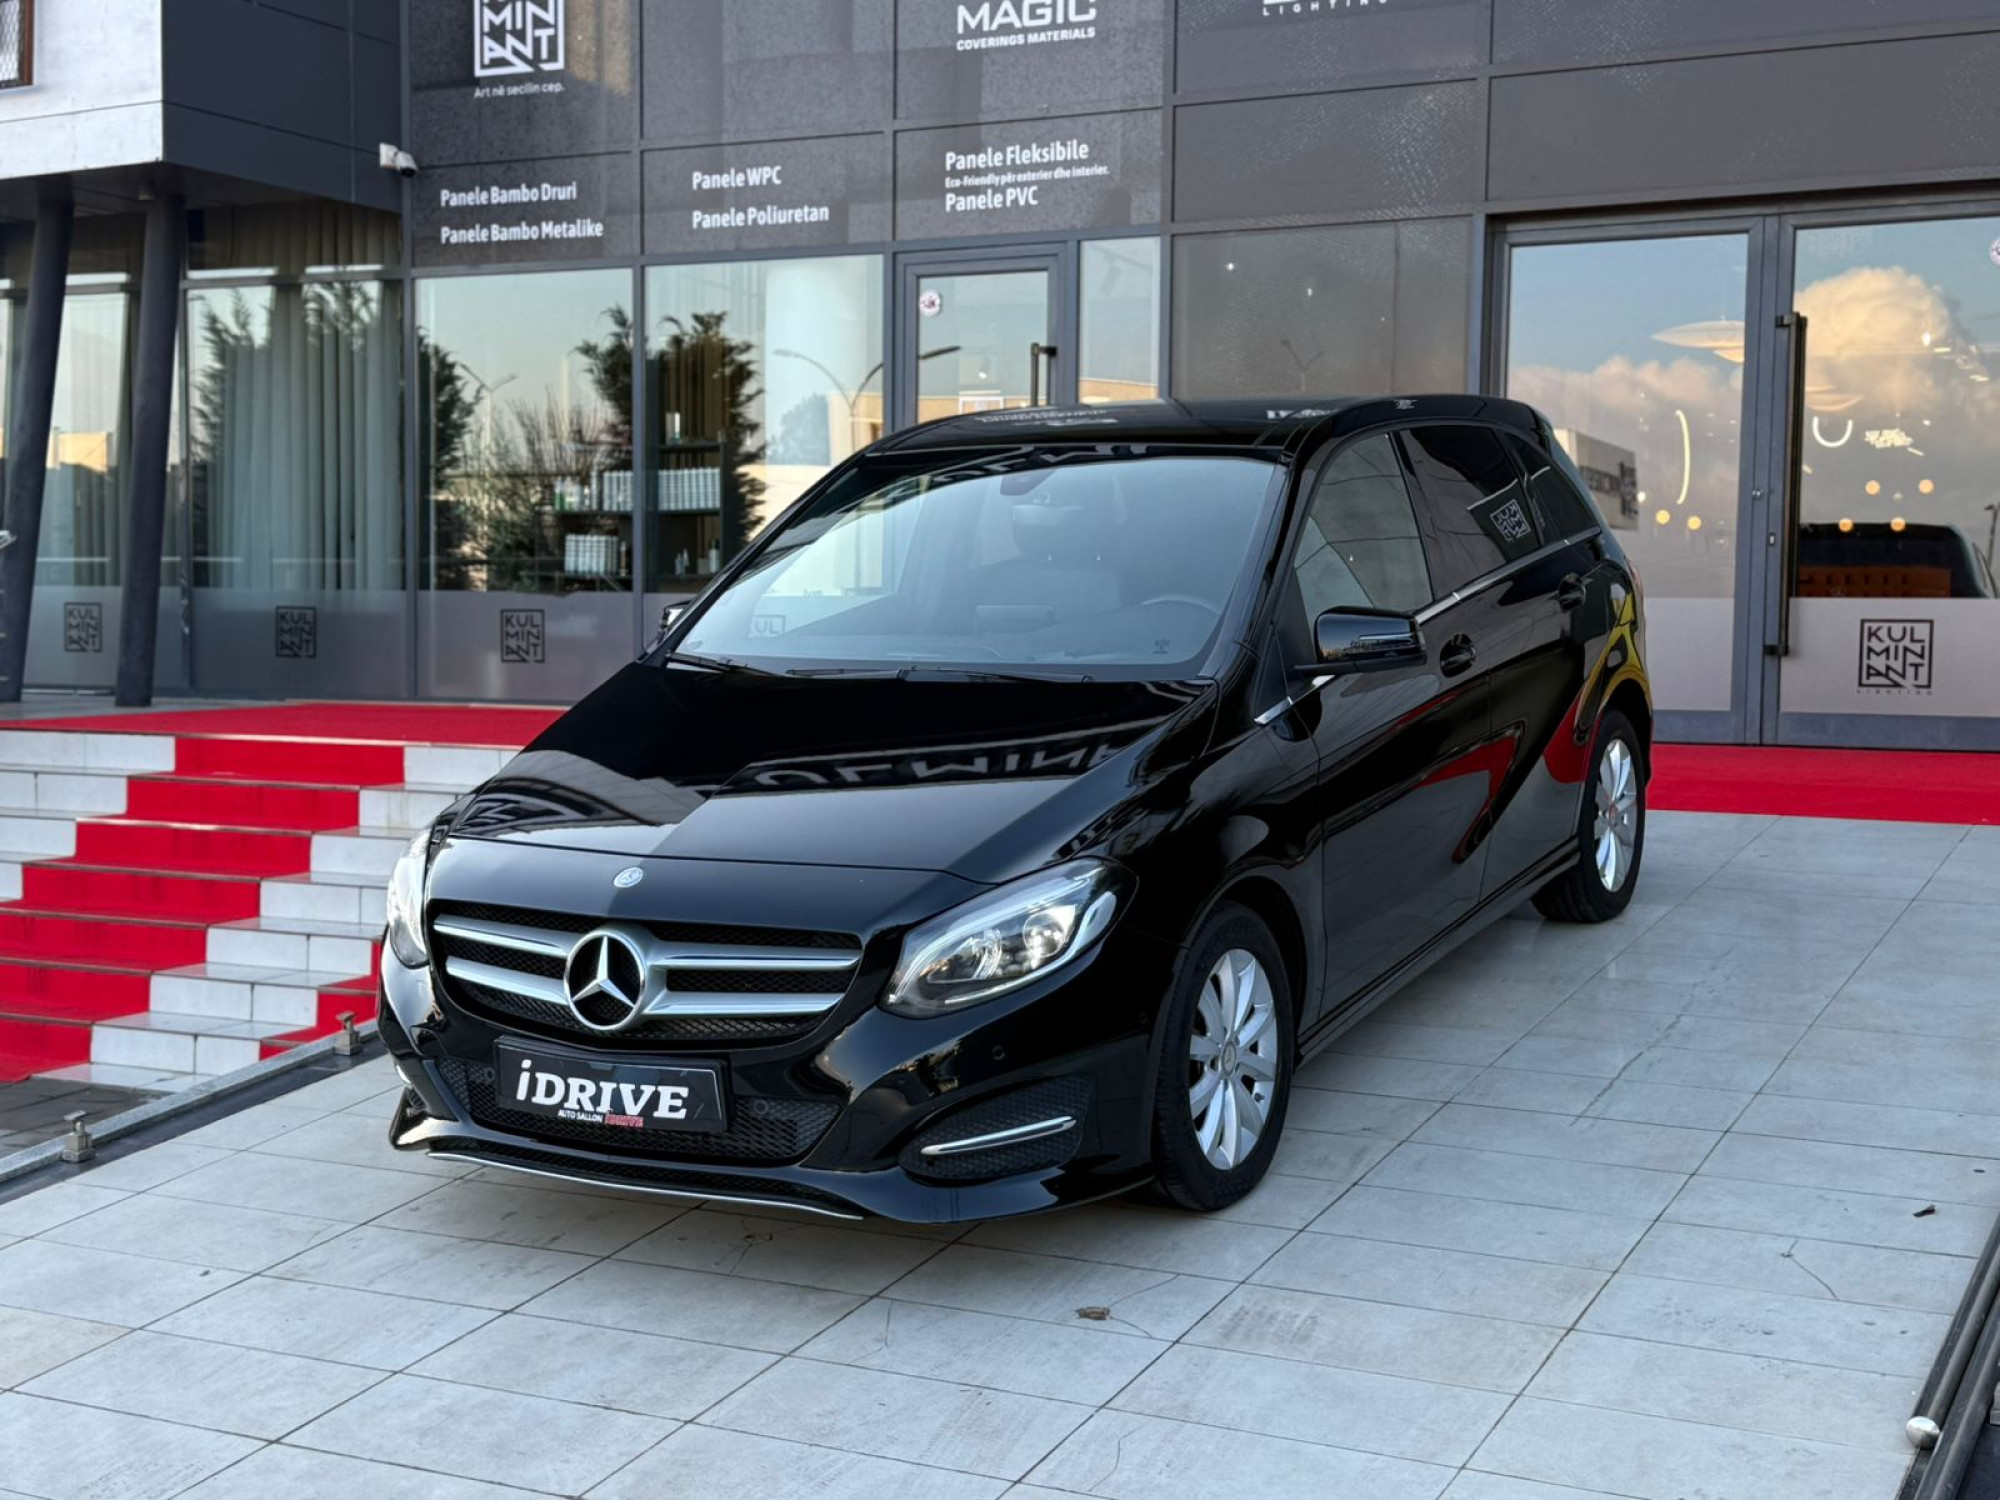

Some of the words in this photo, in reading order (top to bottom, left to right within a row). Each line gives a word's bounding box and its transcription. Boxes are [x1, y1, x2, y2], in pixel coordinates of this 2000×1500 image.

[957, 0, 1097, 34] MAGIC
[956, 34, 1025, 51] COVERINGS
[1027, 26, 1096, 44] MATERIALS
[474, 86, 491, 99] Art
[945, 146, 1004, 171] Panele
[1005, 139, 1090, 166] Fleksibile
[692, 167, 746, 191] Panele
[746, 165, 782, 186] WPC
[440, 185, 489, 207] Panele
[490, 183, 539, 205] Bambo
[541, 180, 578, 201] Druri
[945, 188, 1004, 212] Panele
[1005, 186, 1038, 208] PVC
[692, 207, 746, 230] Panele
[747, 204, 830, 226] Poliuretan
[440, 223, 489, 245] Panele
[490, 221, 539, 242] Bambo
[541, 217, 604, 240] Metalike
[504, 614, 540, 628] KUL
[504, 629, 540, 642] MIN
[1867, 626, 1925, 643] KUL
[504, 642, 540, 658] ANT
[1866, 645, 1925, 661] MIN
[1866, 661, 1925, 681] ANT
[516, 1059, 689, 1120] iDRIVE
[557, 1109, 576, 1120] AUTO
[576, 1111, 604, 1123] SALLON
